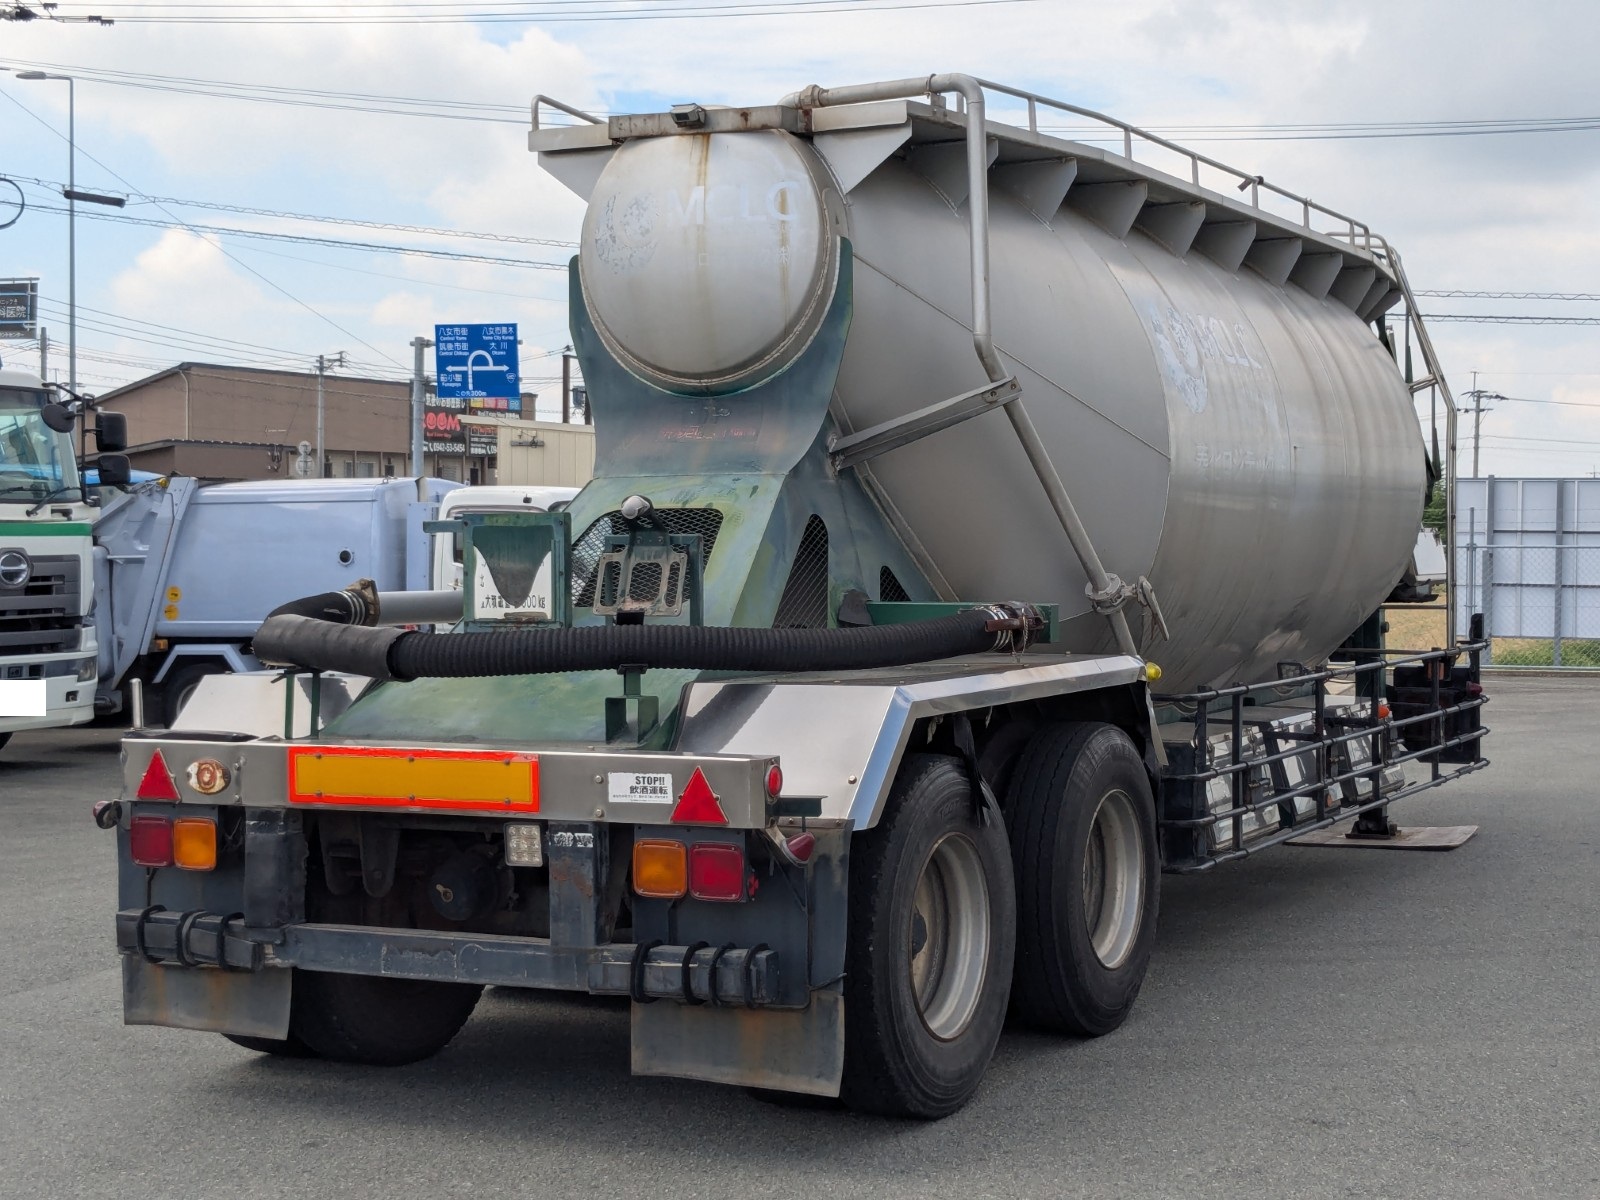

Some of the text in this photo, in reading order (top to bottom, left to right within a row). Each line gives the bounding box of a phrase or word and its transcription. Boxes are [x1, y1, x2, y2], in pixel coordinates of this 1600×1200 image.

[422, 411, 461, 432] OOM
[635, 776, 665, 785] STOP!!
[629, 785, 668, 795] 飲酒運転
